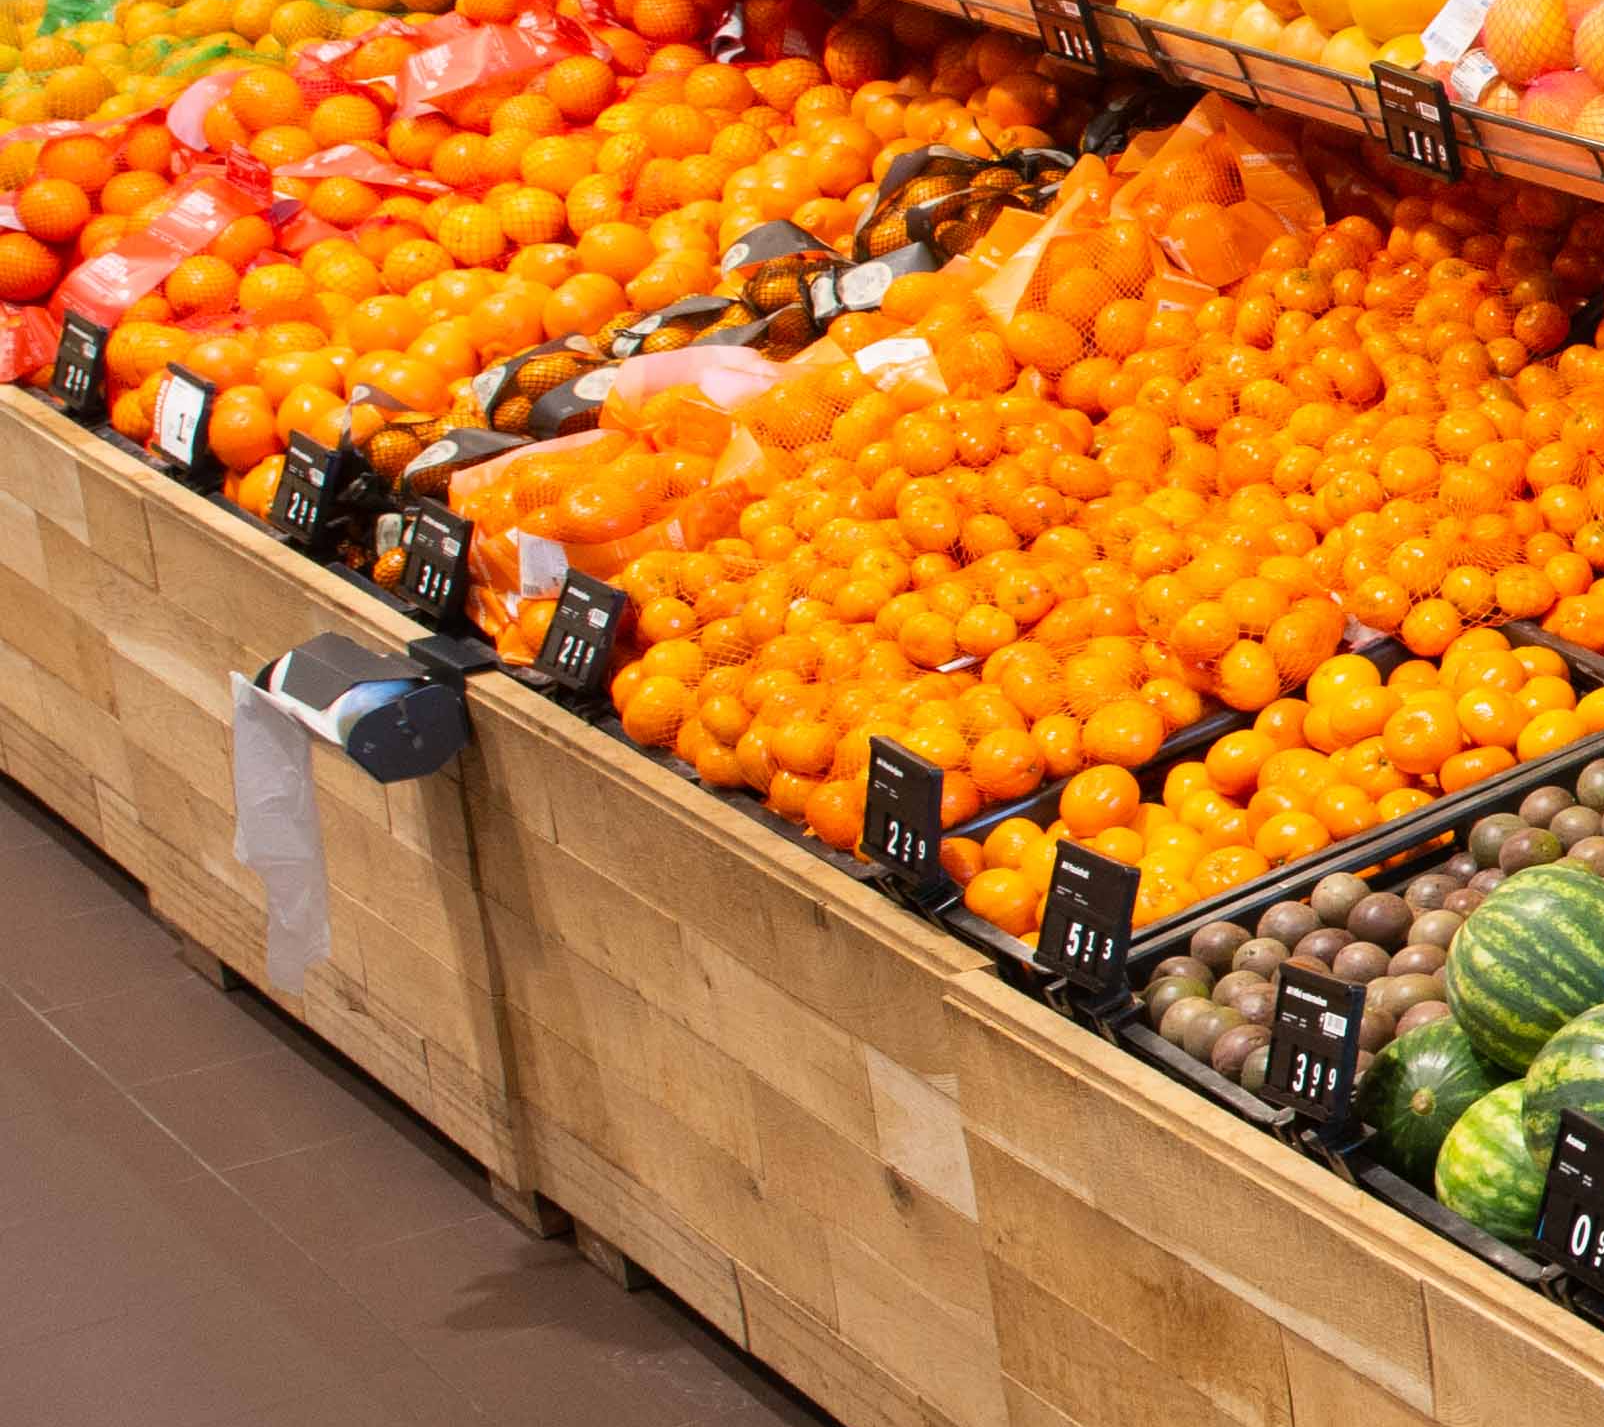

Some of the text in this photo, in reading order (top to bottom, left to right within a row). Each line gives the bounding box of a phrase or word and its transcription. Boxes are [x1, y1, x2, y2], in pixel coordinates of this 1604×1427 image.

[887, 820, 926, 863] 2.29
[1066, 922, 1113, 963] 5.13
[1292, 1053, 1338, 1098] 3.99
